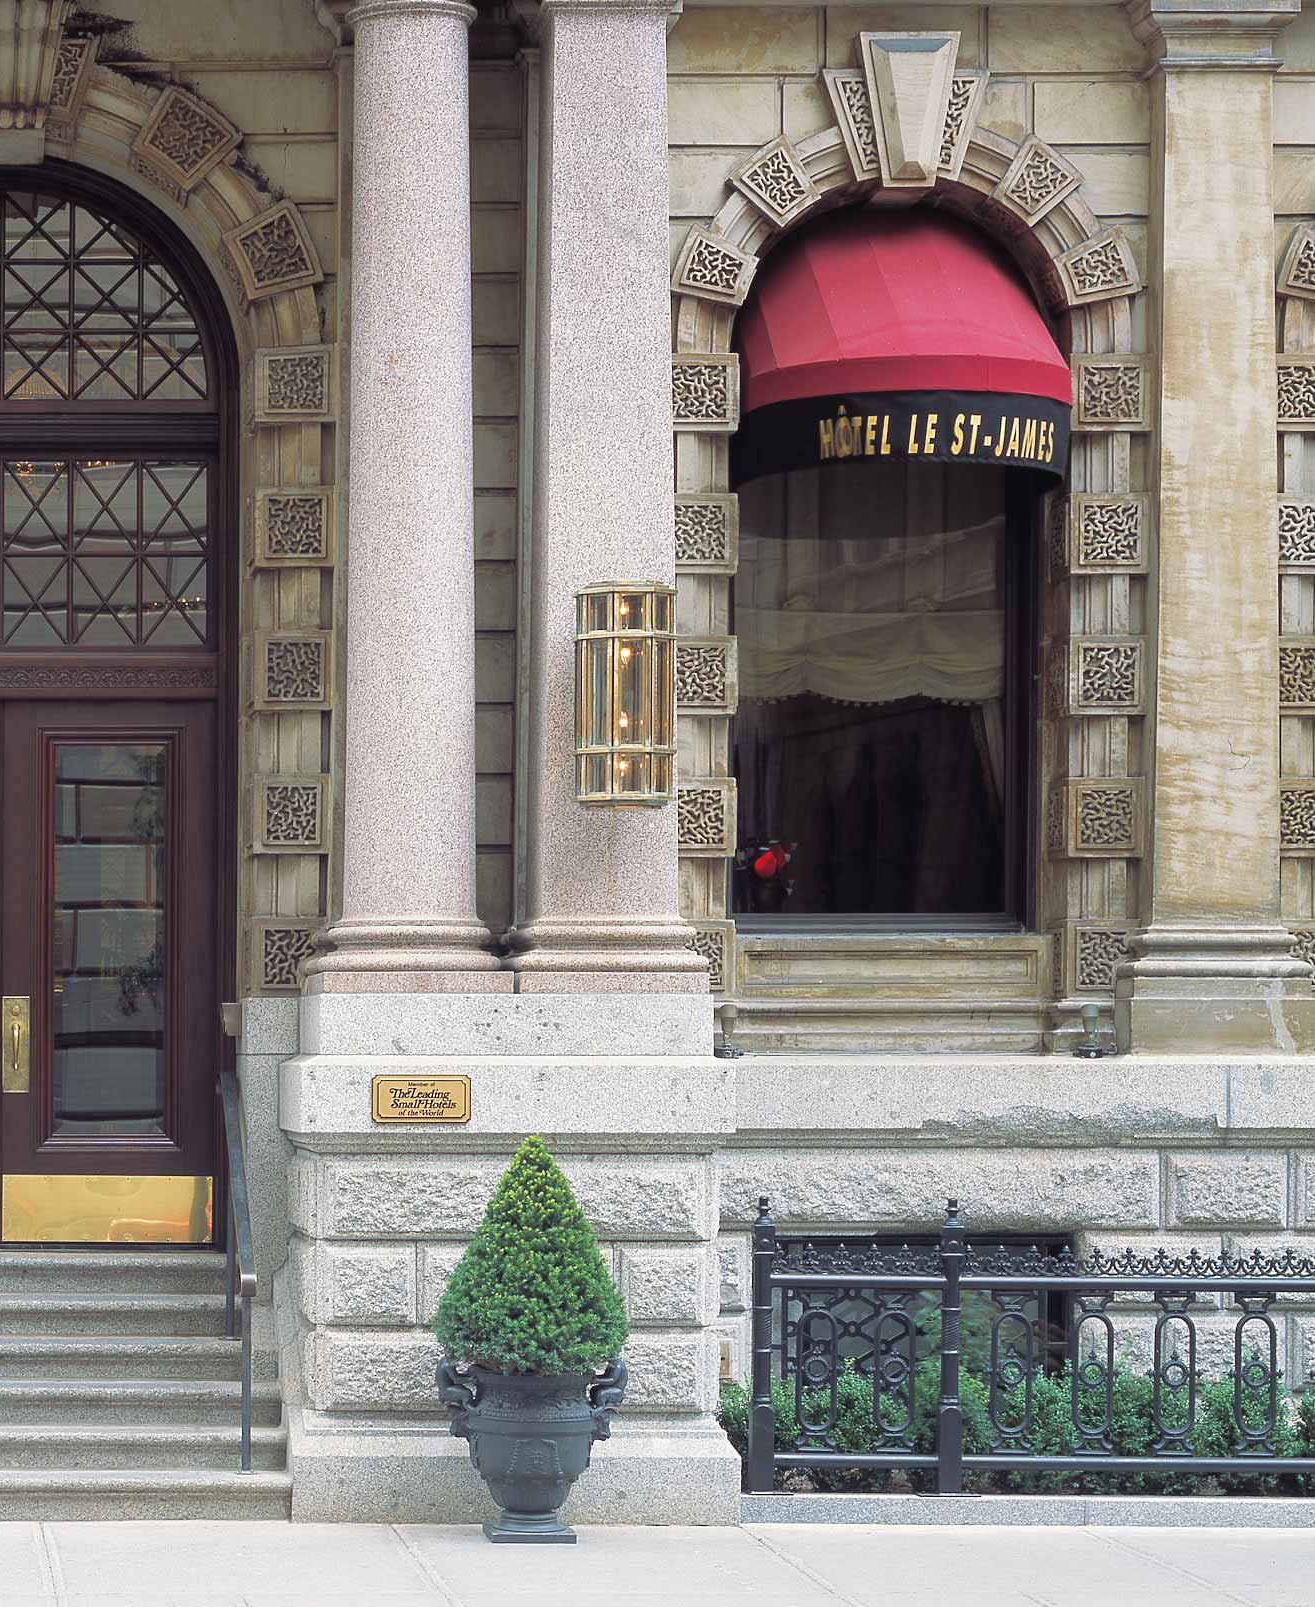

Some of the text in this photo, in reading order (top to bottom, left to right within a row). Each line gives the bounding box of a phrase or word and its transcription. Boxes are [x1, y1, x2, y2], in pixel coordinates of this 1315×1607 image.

[818, 404, 1055, 463] HÔTEL LE ST-JAMES
[389, 1087, 451, 1101] The Leading
[391, 1098, 456, 1109] Small Hotels
